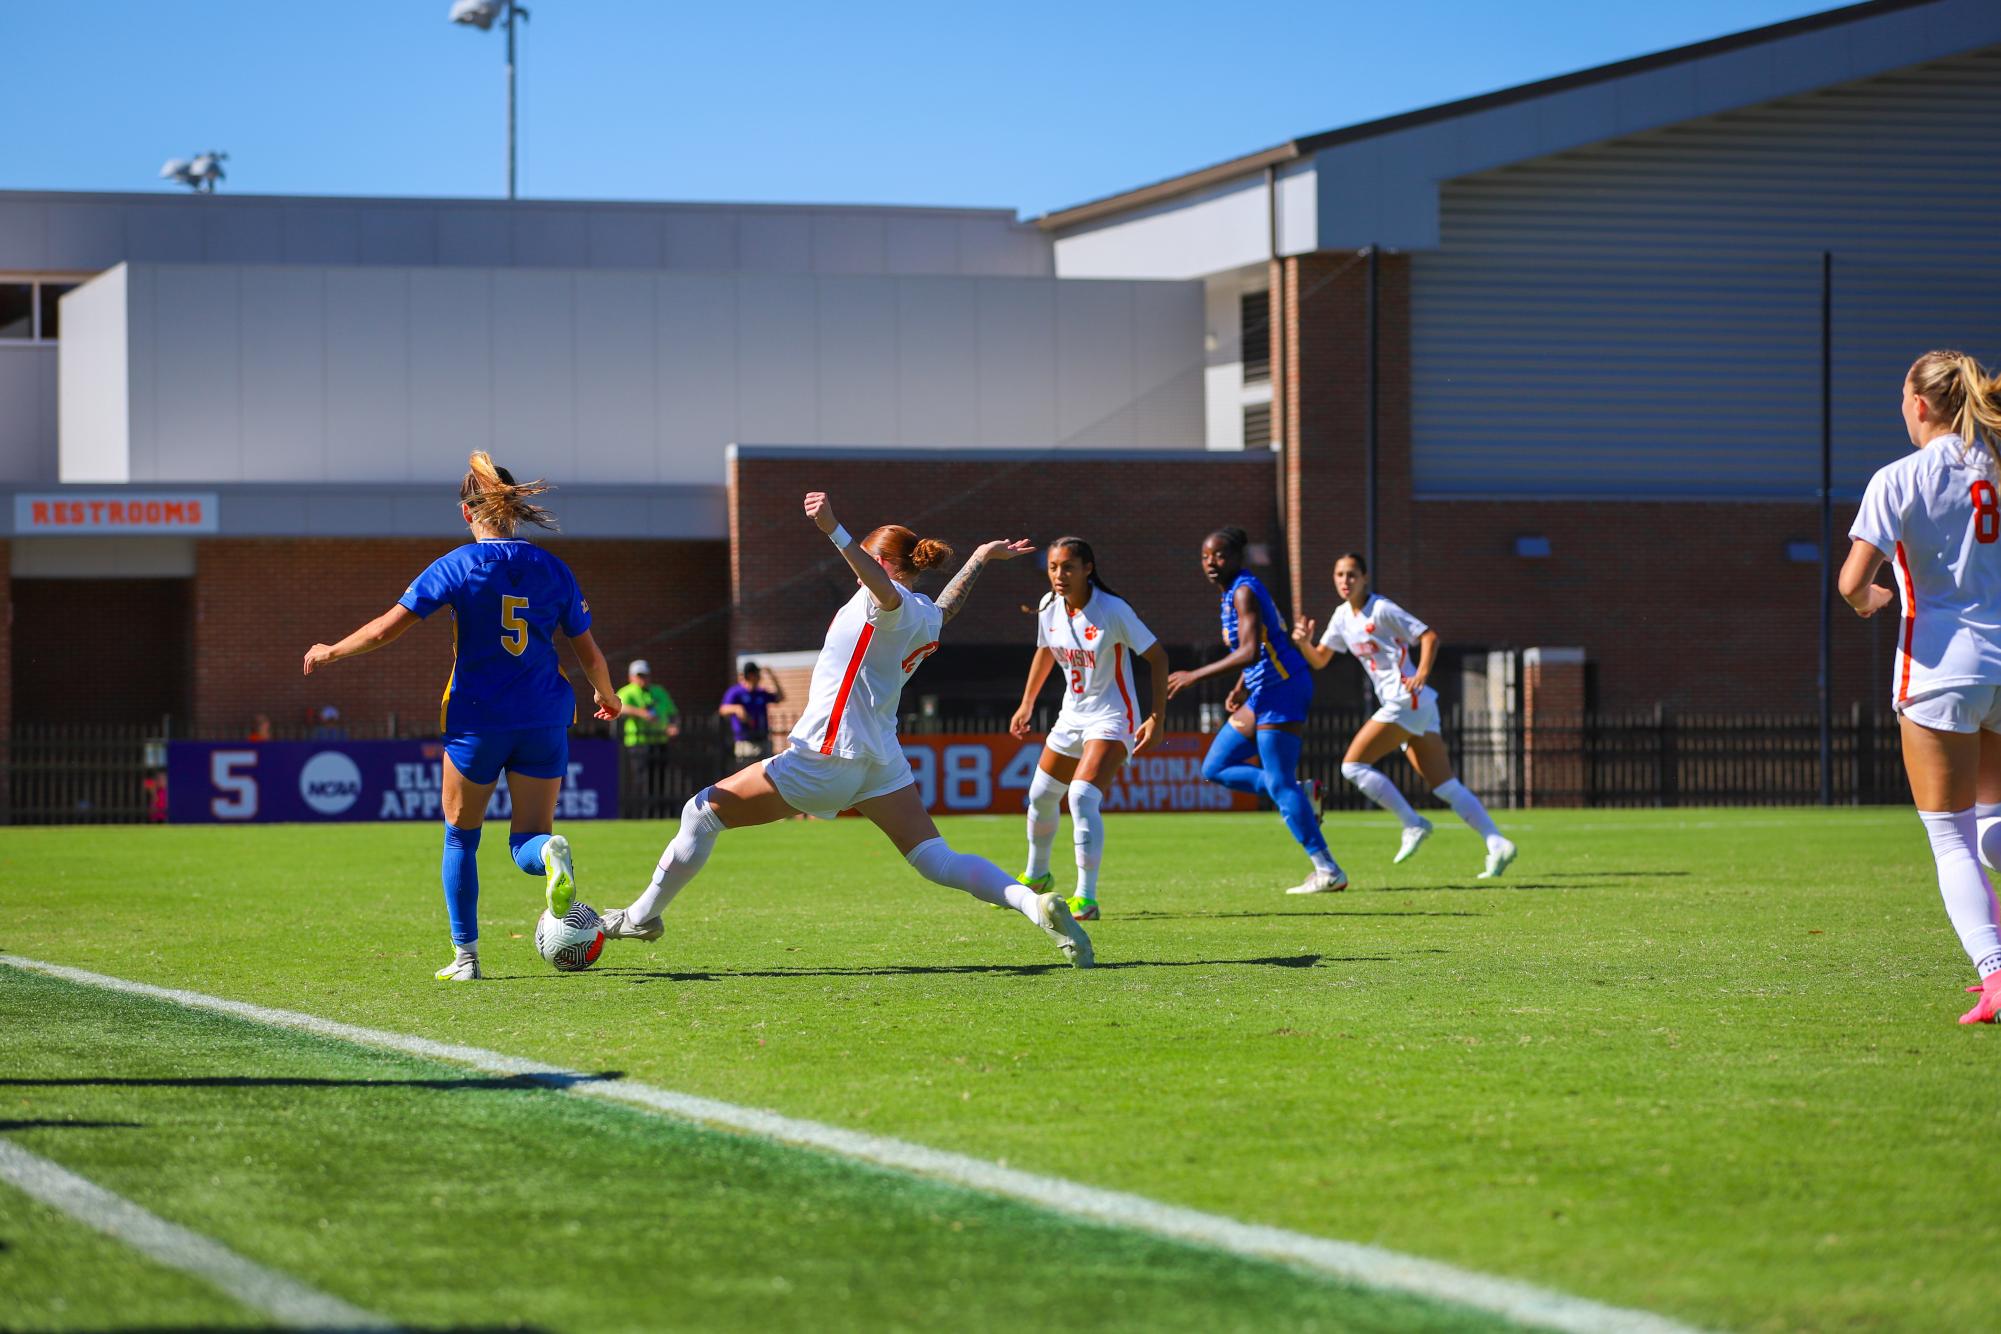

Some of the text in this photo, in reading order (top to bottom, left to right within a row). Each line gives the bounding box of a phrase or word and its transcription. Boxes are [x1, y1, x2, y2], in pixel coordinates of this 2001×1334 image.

[32, 500, 201, 526] RESTROOMS
[1970, 479, 2000, 545] 8
[500, 594, 529, 657] 5
[1070, 669, 1085, 694] 2
[211, 750, 258, 819] 5
[308, 780, 358, 798] NCAA
[901, 743, 1043, 810] 984
[1102, 784, 1233, 810] AMPIONS
